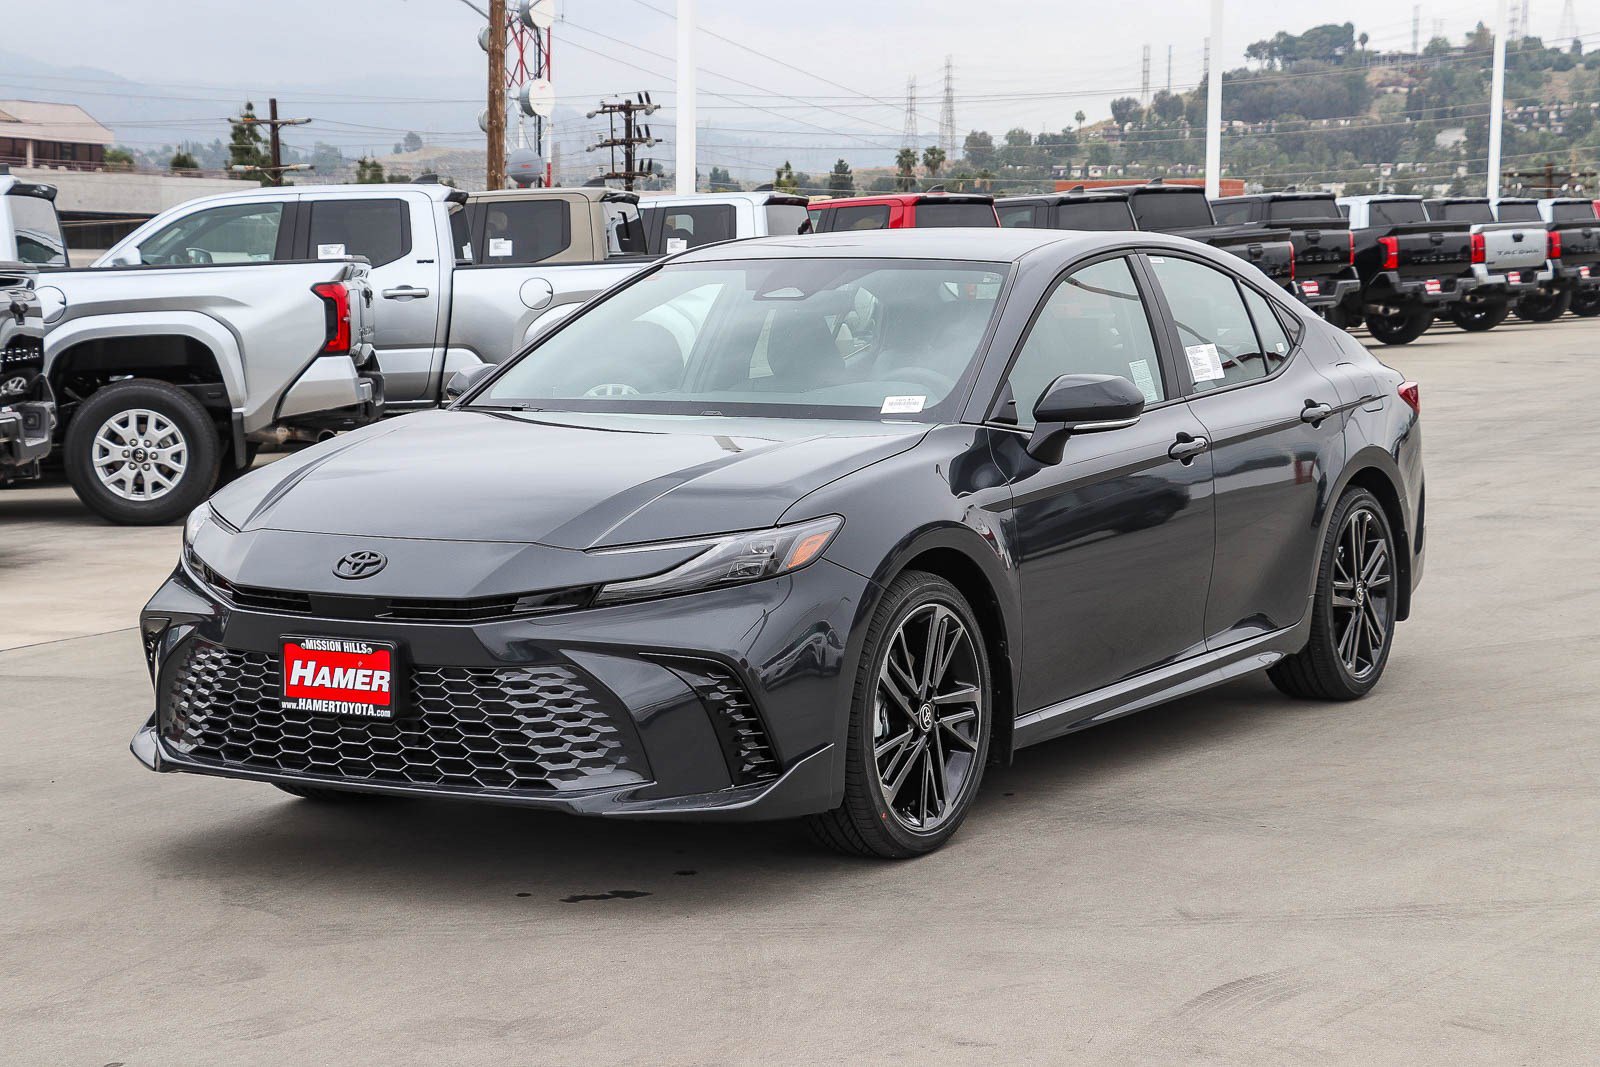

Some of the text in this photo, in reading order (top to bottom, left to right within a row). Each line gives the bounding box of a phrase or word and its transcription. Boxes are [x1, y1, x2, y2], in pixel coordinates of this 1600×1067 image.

[1297, 254, 1340, 262] ACOMA
[1497, 247, 1539, 257] TACOMA
[305, 639, 367, 654] MISSION HILLS
[290, 660, 391, 692] HAMER
[281, 698, 391, 718] www.HAMERTOYOTA.com
